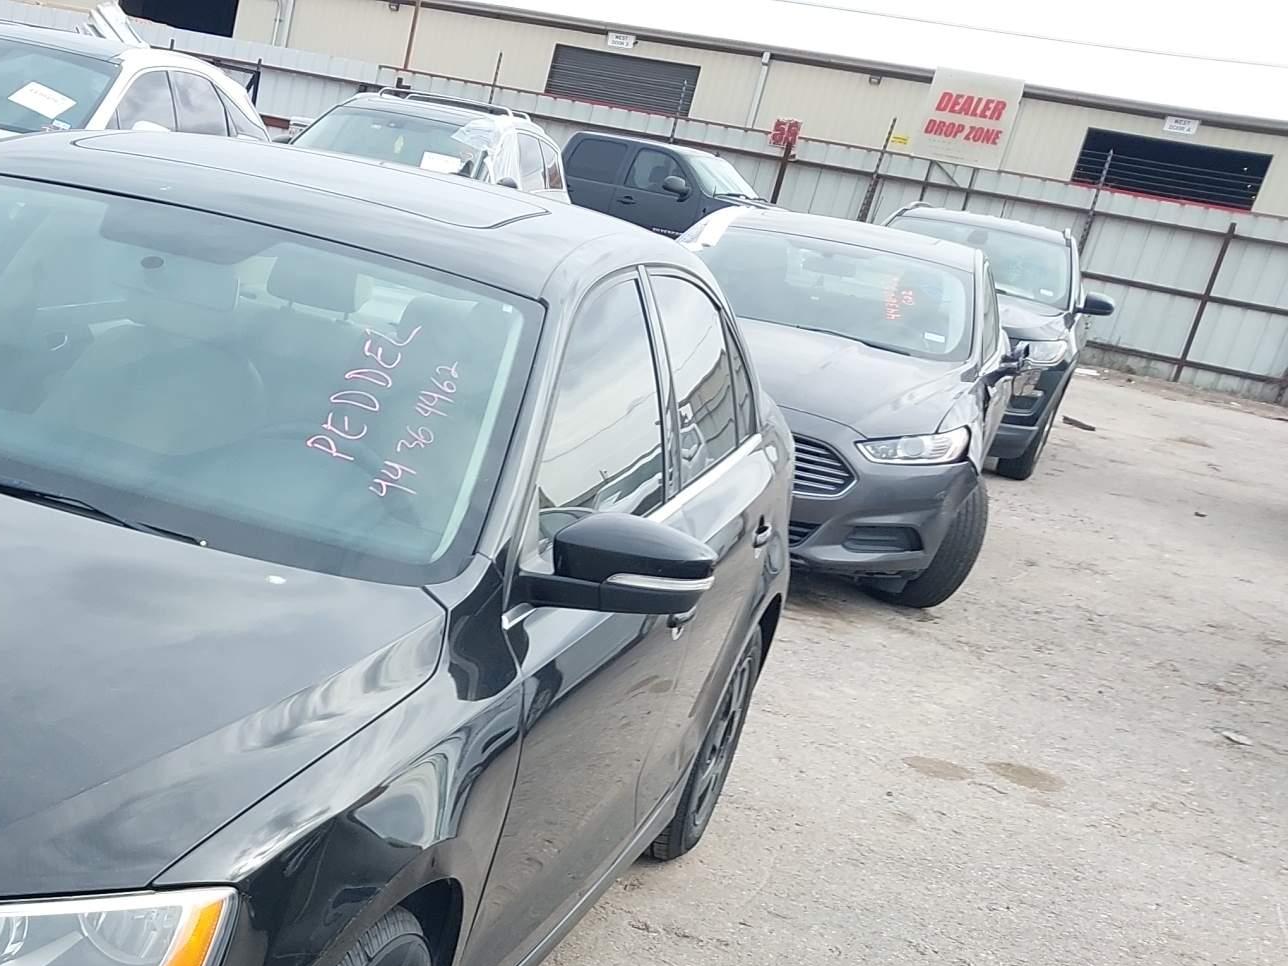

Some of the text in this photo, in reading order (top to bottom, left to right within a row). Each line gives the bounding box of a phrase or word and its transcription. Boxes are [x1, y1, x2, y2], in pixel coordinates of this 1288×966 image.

[935, 91, 1007, 120] DEALER
[924, 118, 1003, 146] DROP ZONE
